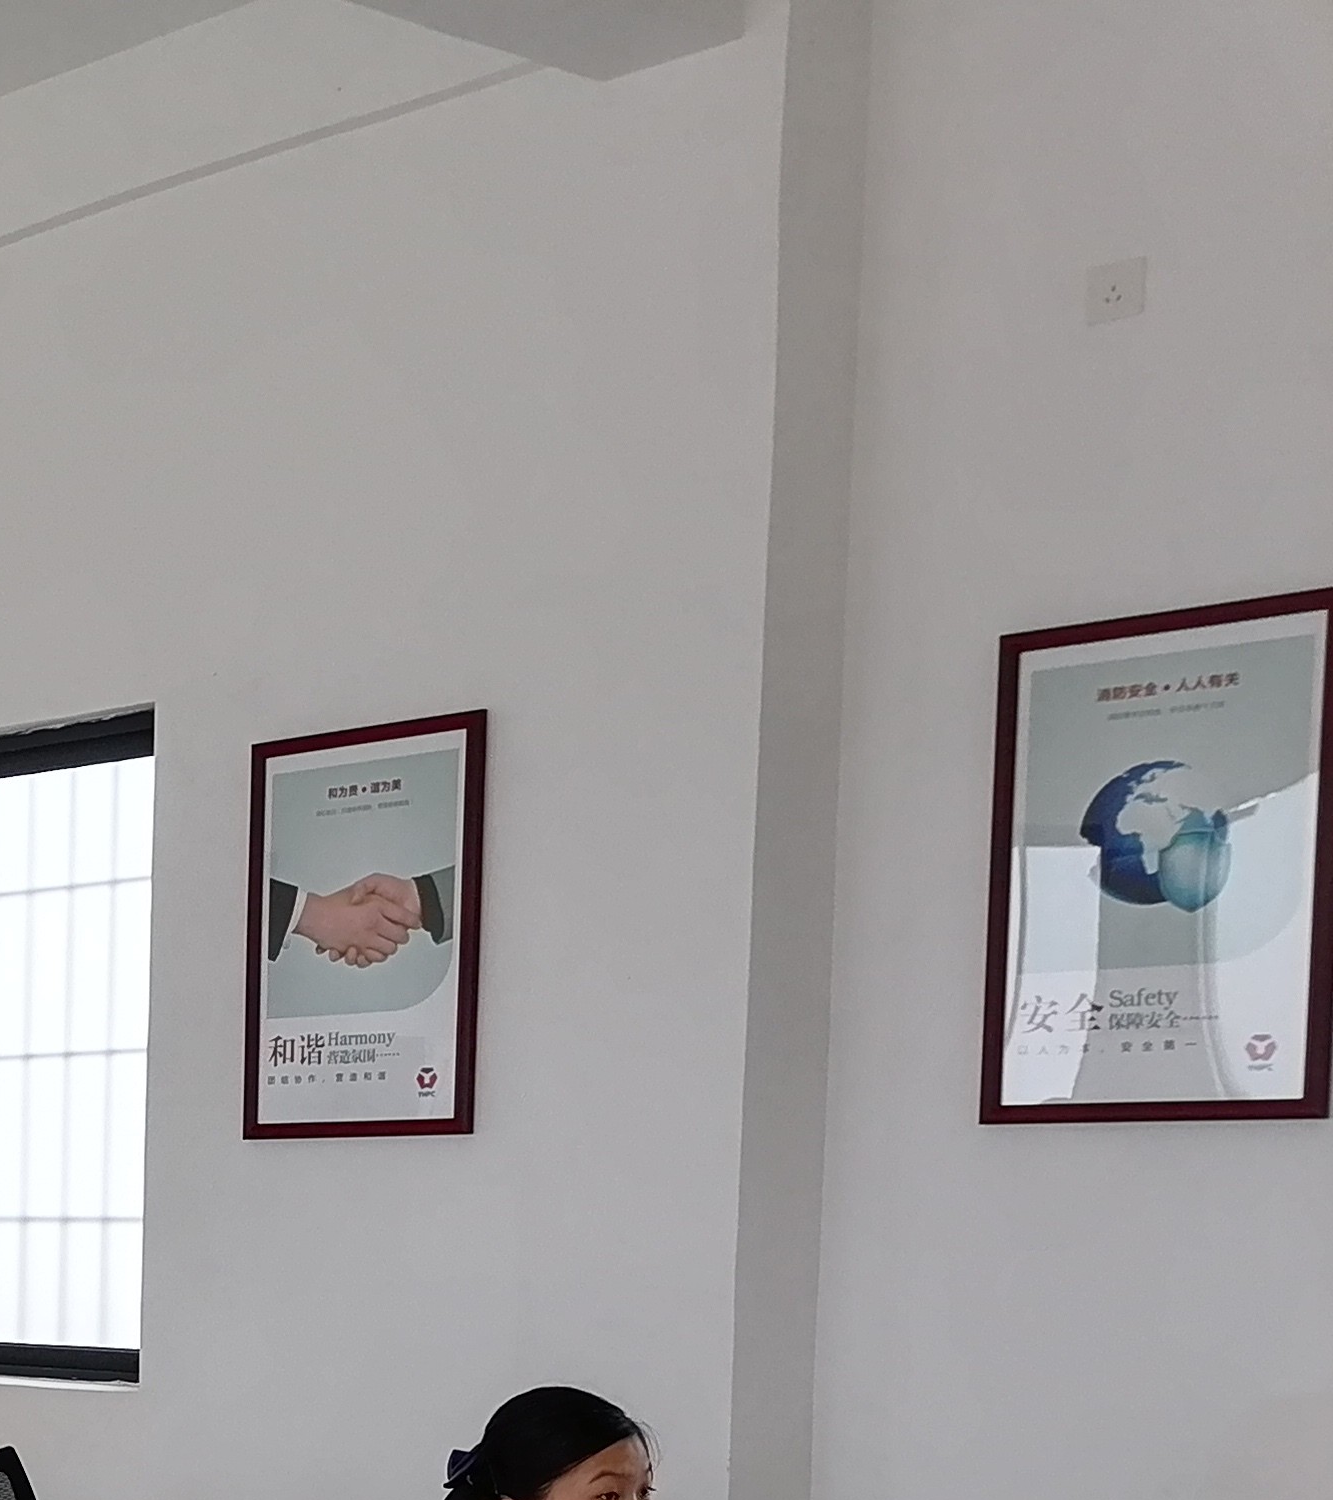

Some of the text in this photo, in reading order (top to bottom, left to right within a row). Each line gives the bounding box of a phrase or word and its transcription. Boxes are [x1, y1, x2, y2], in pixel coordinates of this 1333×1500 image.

[1019, 993, 1104, 1033] 安全
[1108, 987, 1179, 1011] Safety
[268, 1033, 325, 1068] 和谐
[327, 1031, 397, 1048] Harmony
